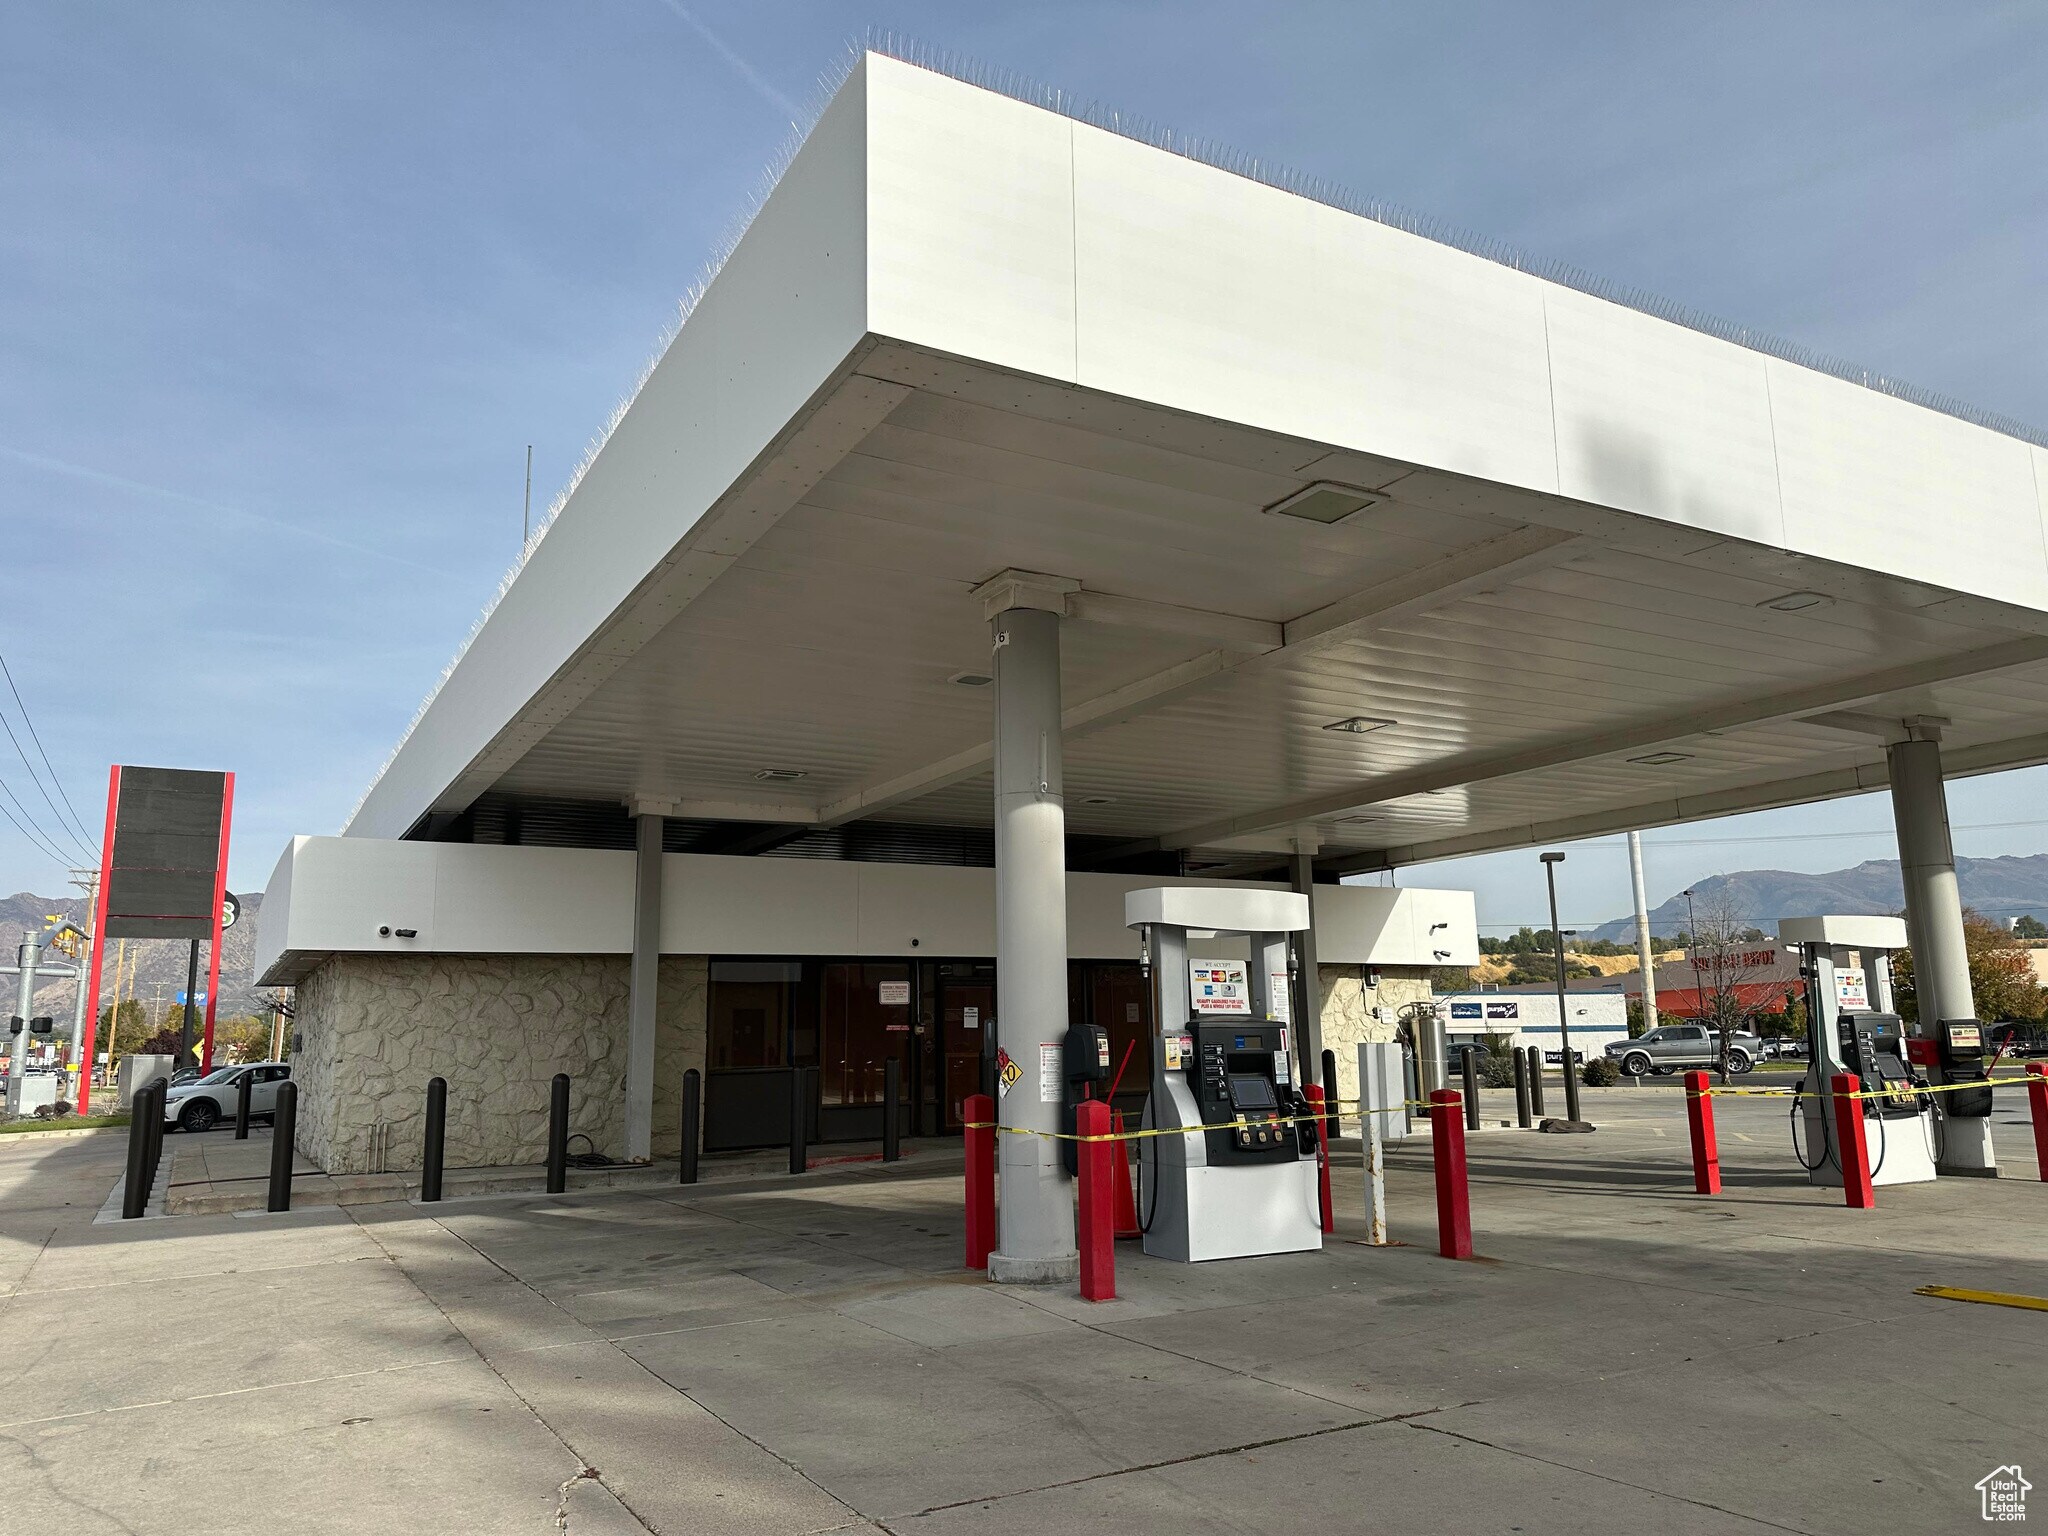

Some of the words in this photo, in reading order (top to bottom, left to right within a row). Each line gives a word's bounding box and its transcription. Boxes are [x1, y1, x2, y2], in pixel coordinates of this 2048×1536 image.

[1743, 950, 1775, 966] DEPOT
[1487, 1005, 1507, 1013] purple
[1007, 1065, 1015, 1081] 0
